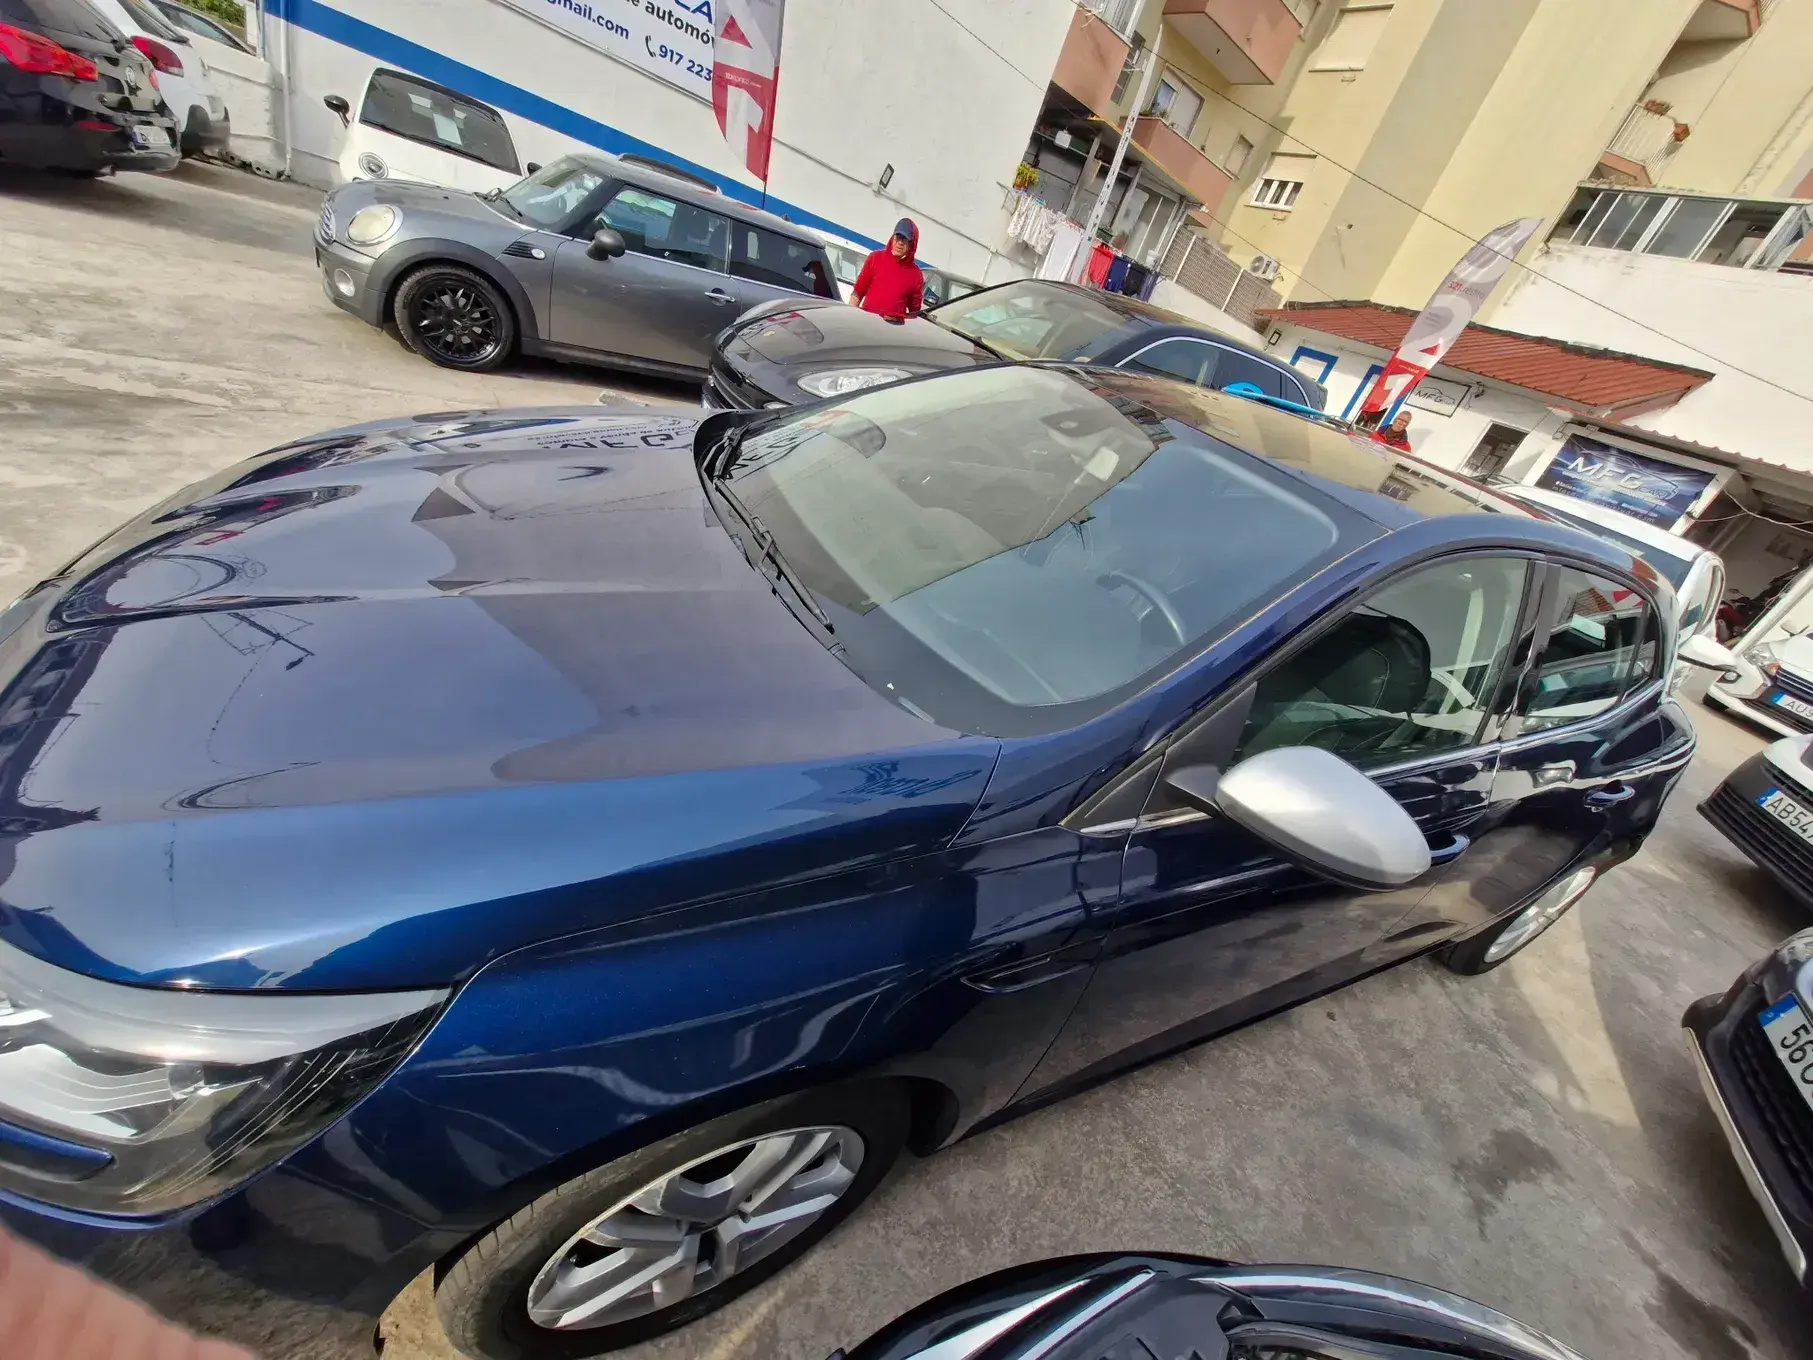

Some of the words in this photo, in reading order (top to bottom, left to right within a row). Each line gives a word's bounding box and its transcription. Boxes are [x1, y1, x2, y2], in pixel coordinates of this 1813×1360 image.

[658, 44, 684, 66] 917
[686, 59, 713, 82] 223
[1415, 390, 1443, 403] MFG
[1568, 456, 1644, 489] MFG
[1766, 797, 1813, 839] AB54
